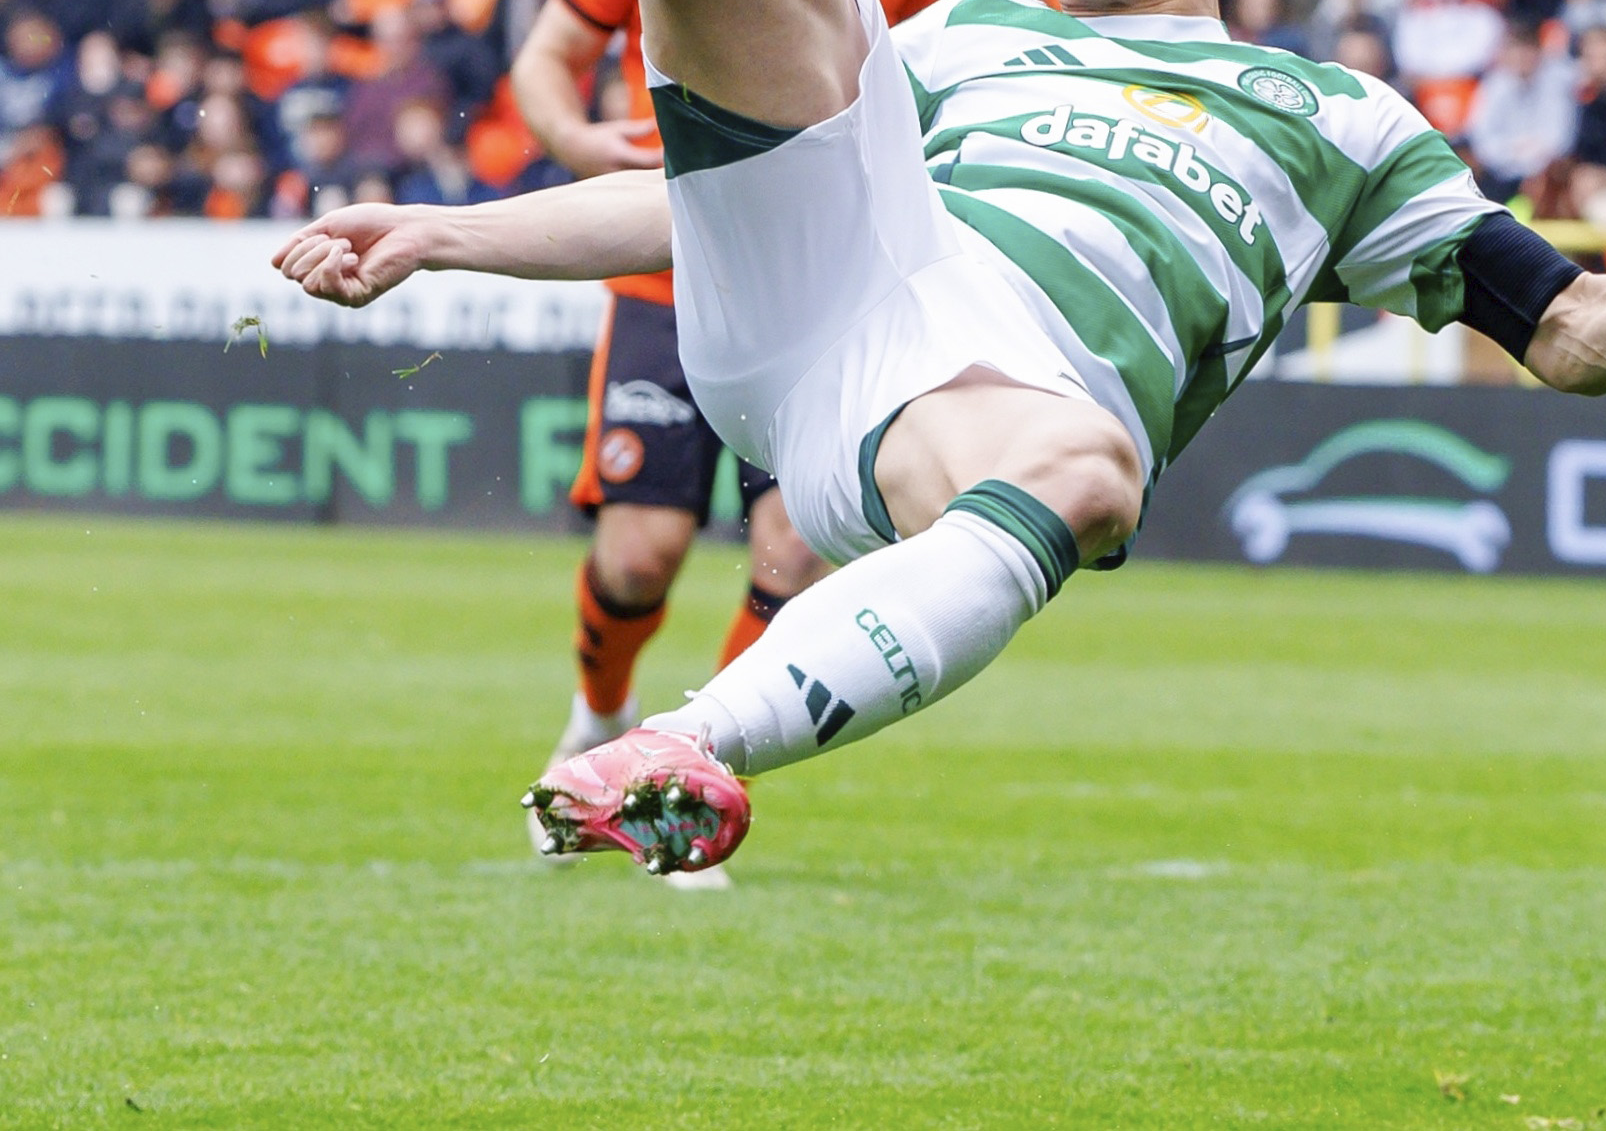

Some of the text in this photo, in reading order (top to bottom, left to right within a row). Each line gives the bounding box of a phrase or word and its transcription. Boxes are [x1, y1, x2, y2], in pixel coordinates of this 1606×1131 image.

[1020, 104, 1262, 246] dafabet
[0, 394, 474, 511] CIDENT
[856, 609, 921, 714] CELTIC
